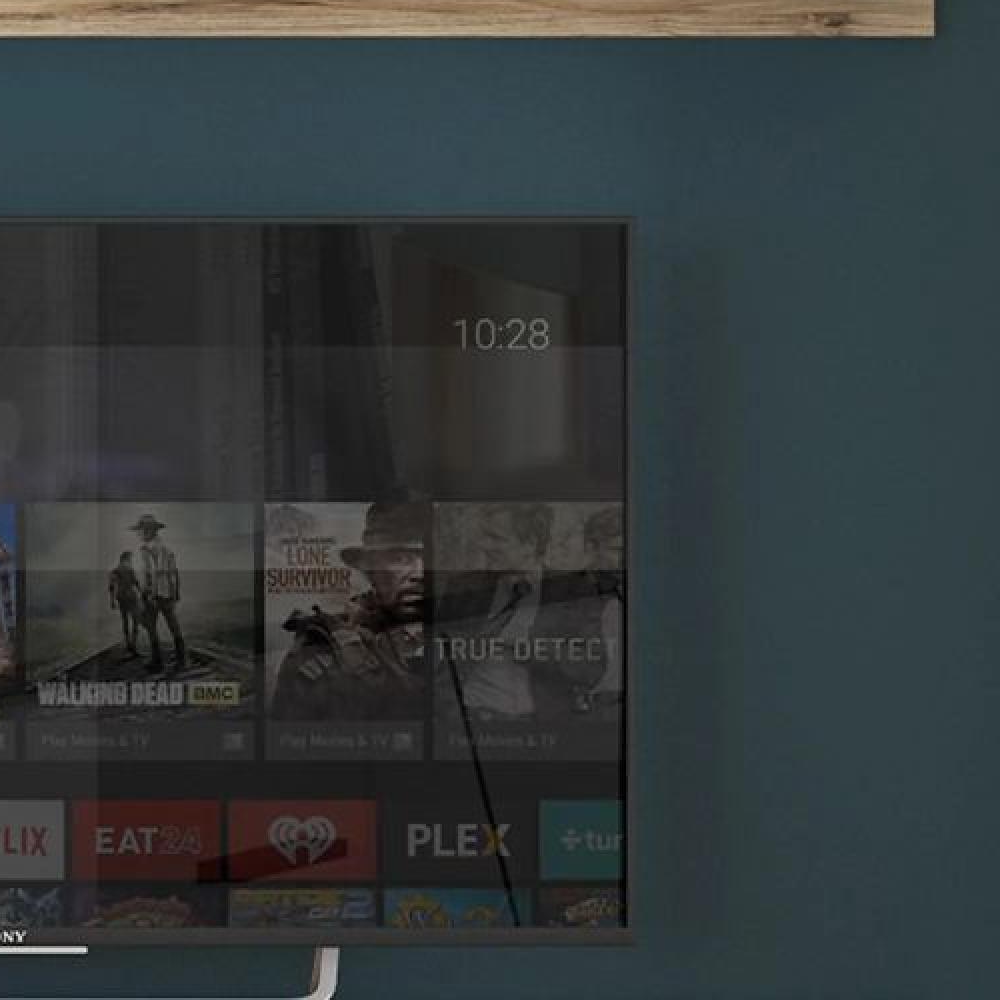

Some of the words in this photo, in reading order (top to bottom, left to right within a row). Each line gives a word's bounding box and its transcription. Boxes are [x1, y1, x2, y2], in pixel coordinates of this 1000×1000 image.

[454, 317, 550, 350] 10:28
[286, 544, 330, 566] LONE
[267, 567, 351, 588] SURVIVOR
[434, 637, 504, 662] TRUE
[130, 682, 184, 705] DEAD
[407, 823, 512, 857] PLEX
